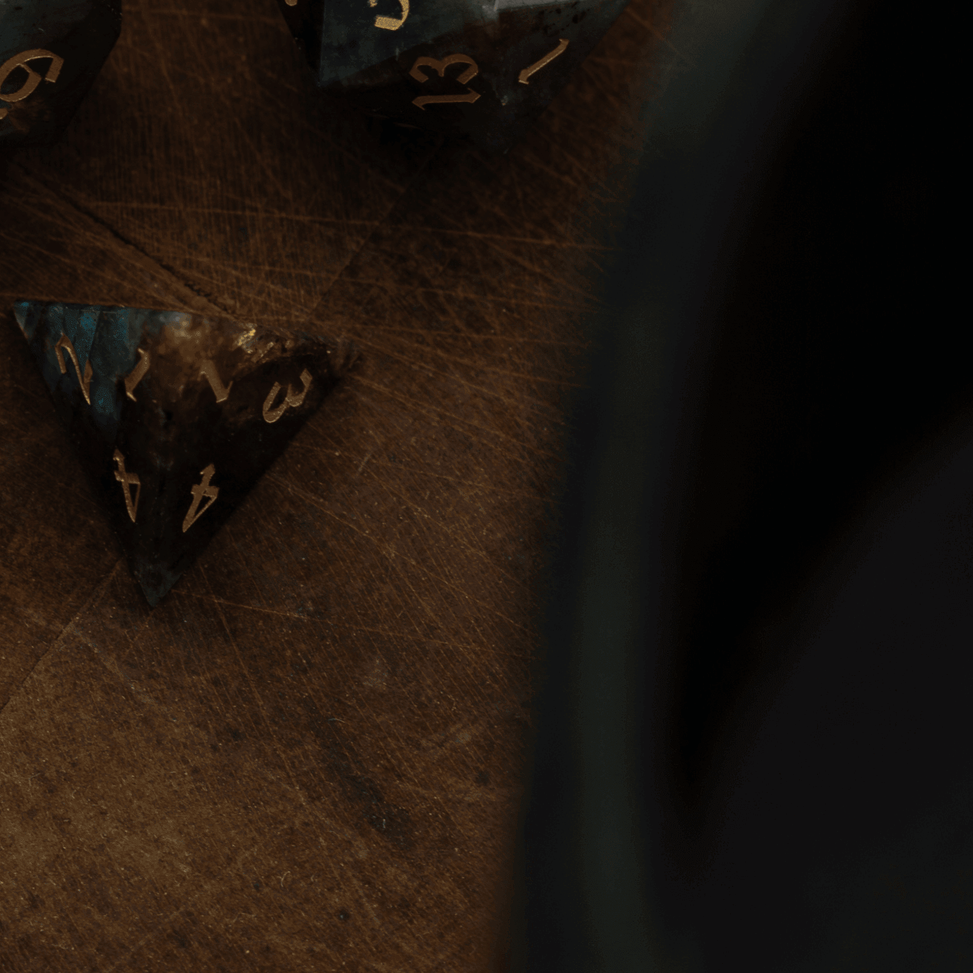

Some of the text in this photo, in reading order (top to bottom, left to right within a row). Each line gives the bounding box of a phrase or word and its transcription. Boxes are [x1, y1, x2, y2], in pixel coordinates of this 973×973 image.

[409, 53, 482, 111] 13
[517, 38, 570, 85] 1
[54, 331, 94, 406] 2
[124, 346, 151, 403] 1
[197, 359, 234, 404] 1
[262, 367, 313, 424] 3
[112, 447, 142, 524] 4
[182, 462, 221, 534] 4
